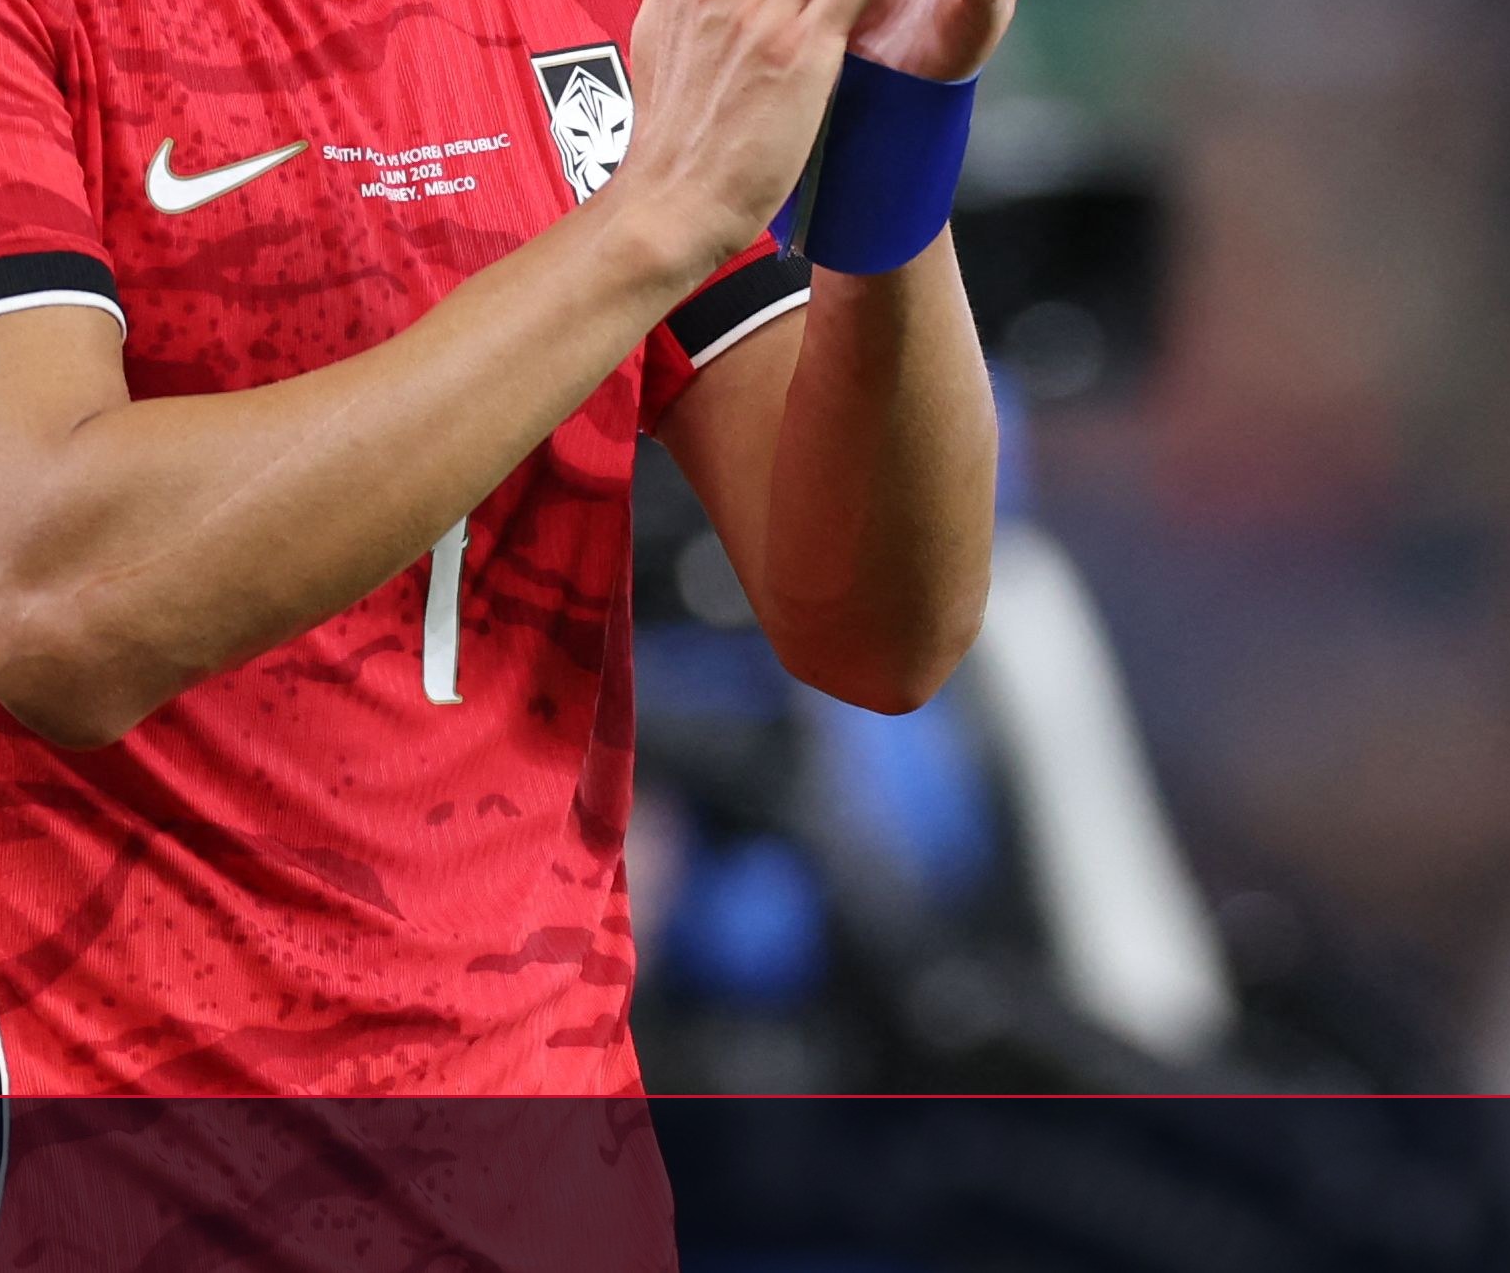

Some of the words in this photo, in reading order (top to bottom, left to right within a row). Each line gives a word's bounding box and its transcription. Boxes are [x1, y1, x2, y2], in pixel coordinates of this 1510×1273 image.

[399, 145, 443, 166] KOREA
[443, 133, 511, 157] REPUBLIC
[409, 162, 443, 182] 2026
[424, 175, 476, 197] MEXICO
